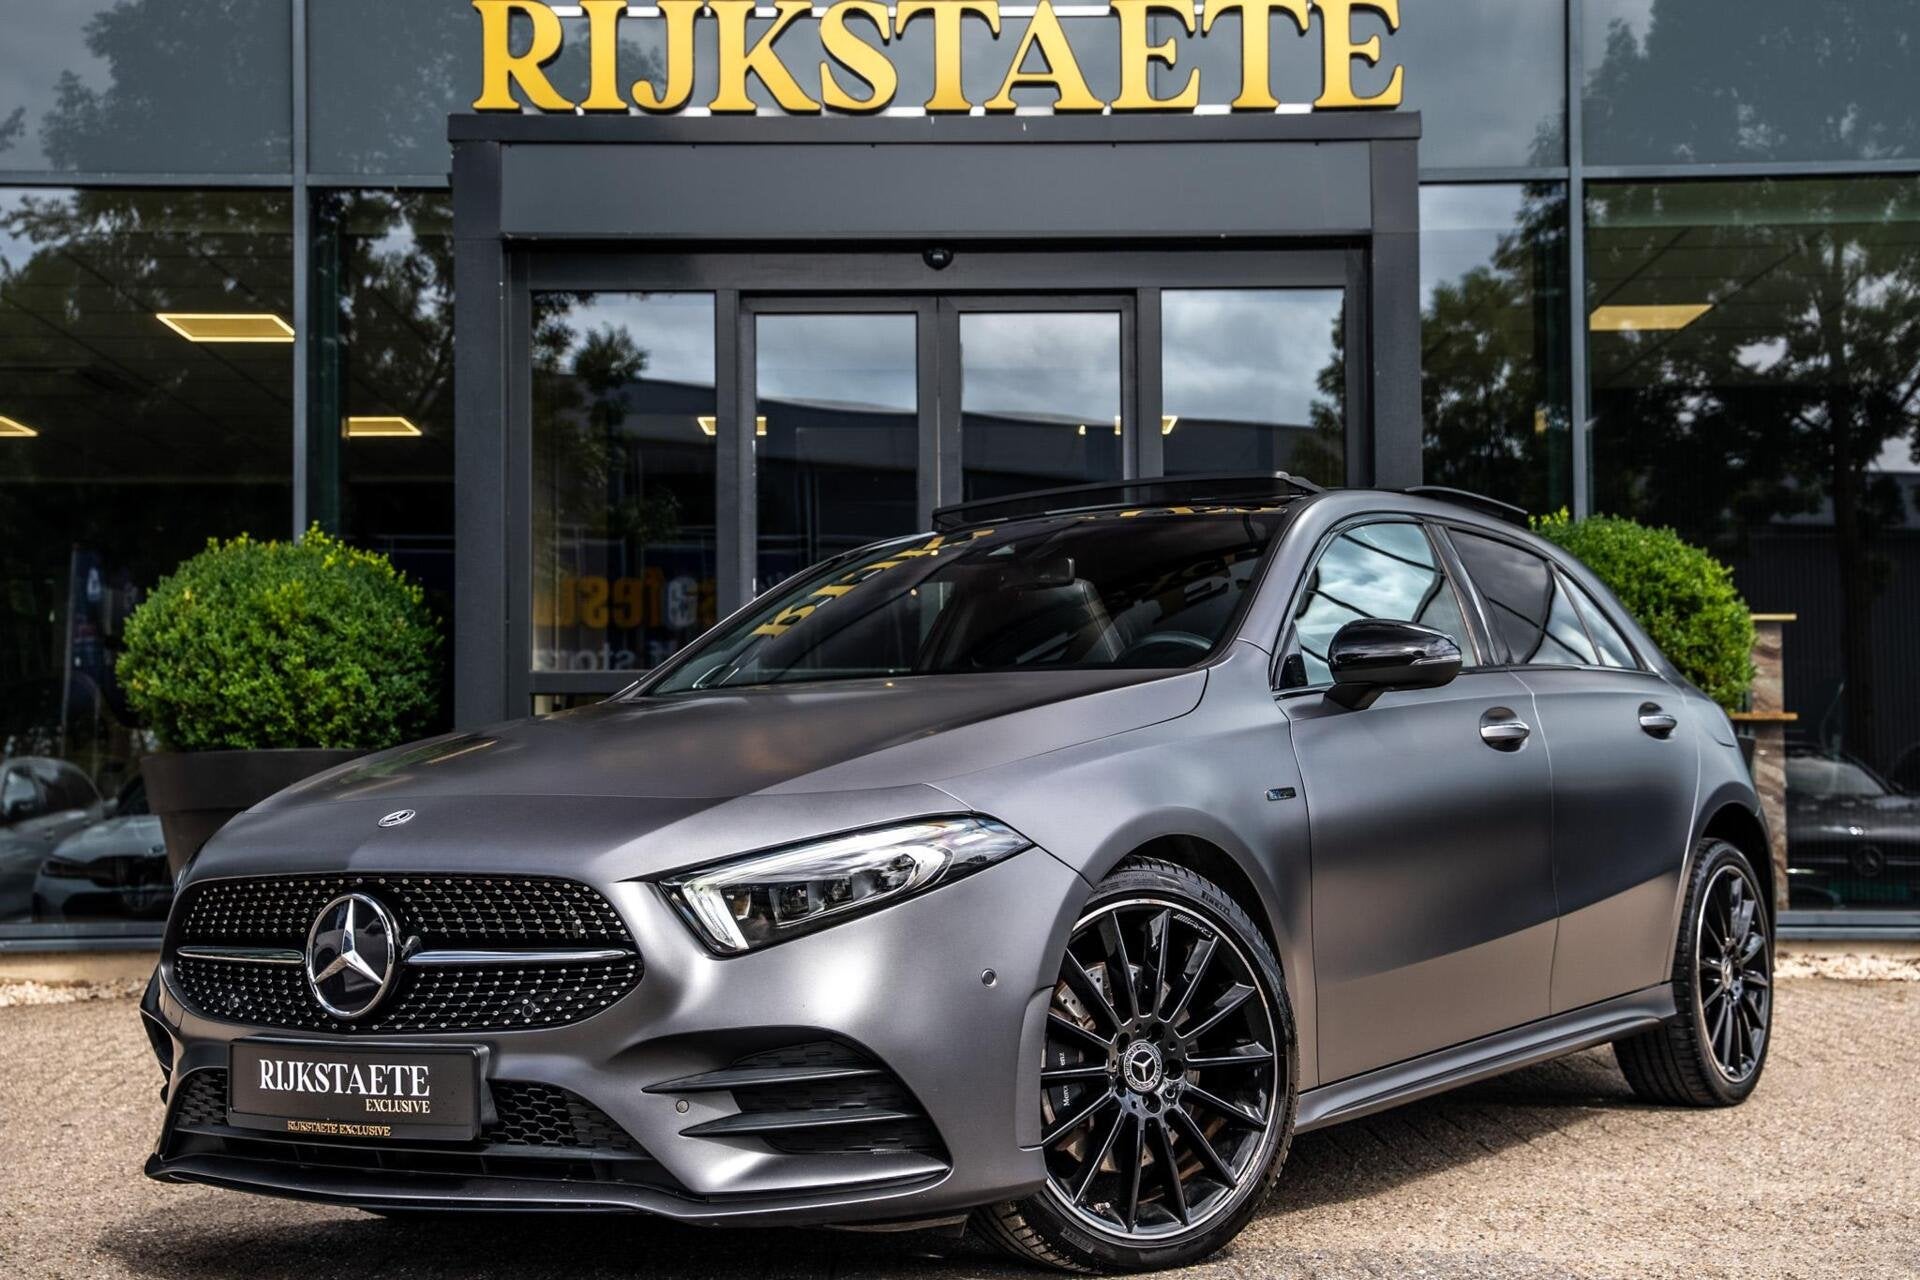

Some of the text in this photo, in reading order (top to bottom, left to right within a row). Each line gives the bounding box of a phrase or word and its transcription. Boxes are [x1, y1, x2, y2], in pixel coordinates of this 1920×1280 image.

[472, 0, 1405, 112] RIJKSTAETE
[259, 1059, 430, 1097] RIJKSTAETE
[366, 1098, 430, 1114] EXCLUSIVE
[287, 1120, 391, 1137] RIJKSTAETE EXCLUSIVE
